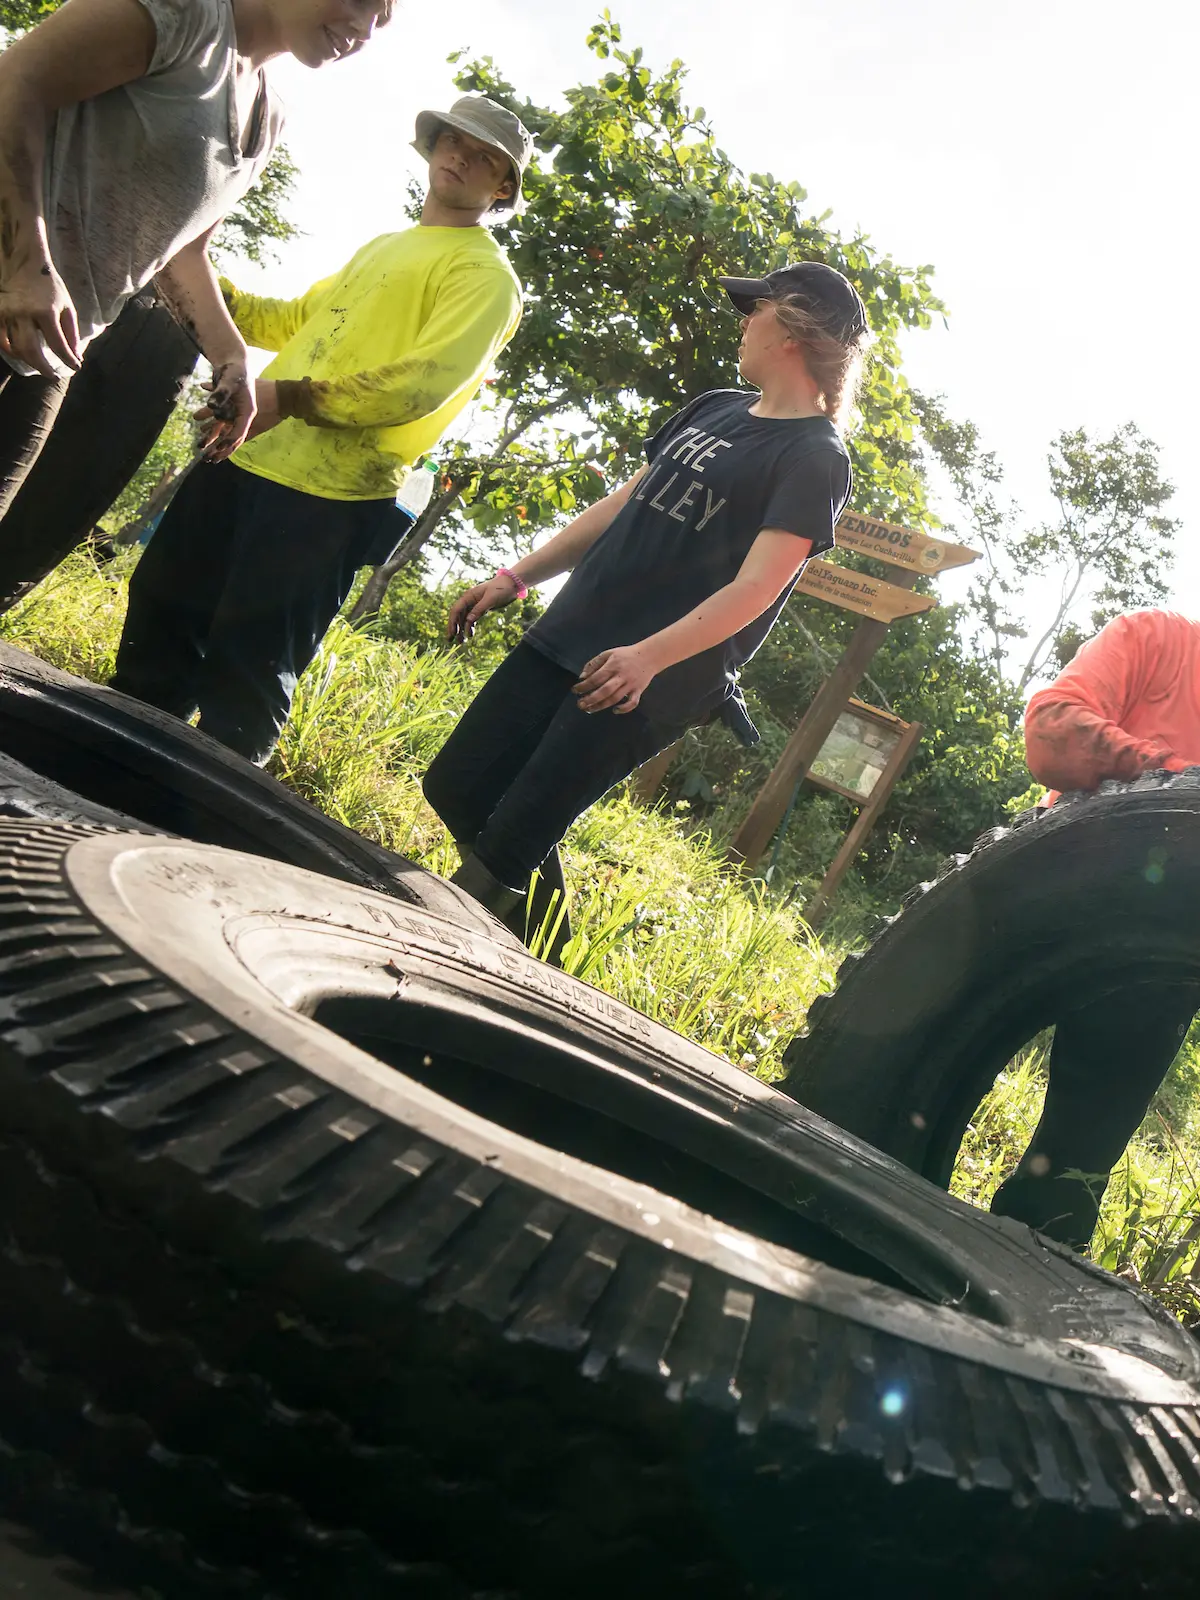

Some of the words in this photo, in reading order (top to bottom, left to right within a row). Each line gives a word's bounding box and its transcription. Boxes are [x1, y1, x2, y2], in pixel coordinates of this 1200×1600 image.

[662, 426, 733, 473] THE
[859, 582, 878, 598] Inc.
[359, 902, 474, 955] FLEET
[497, 952, 653, 1037] CARRIER
